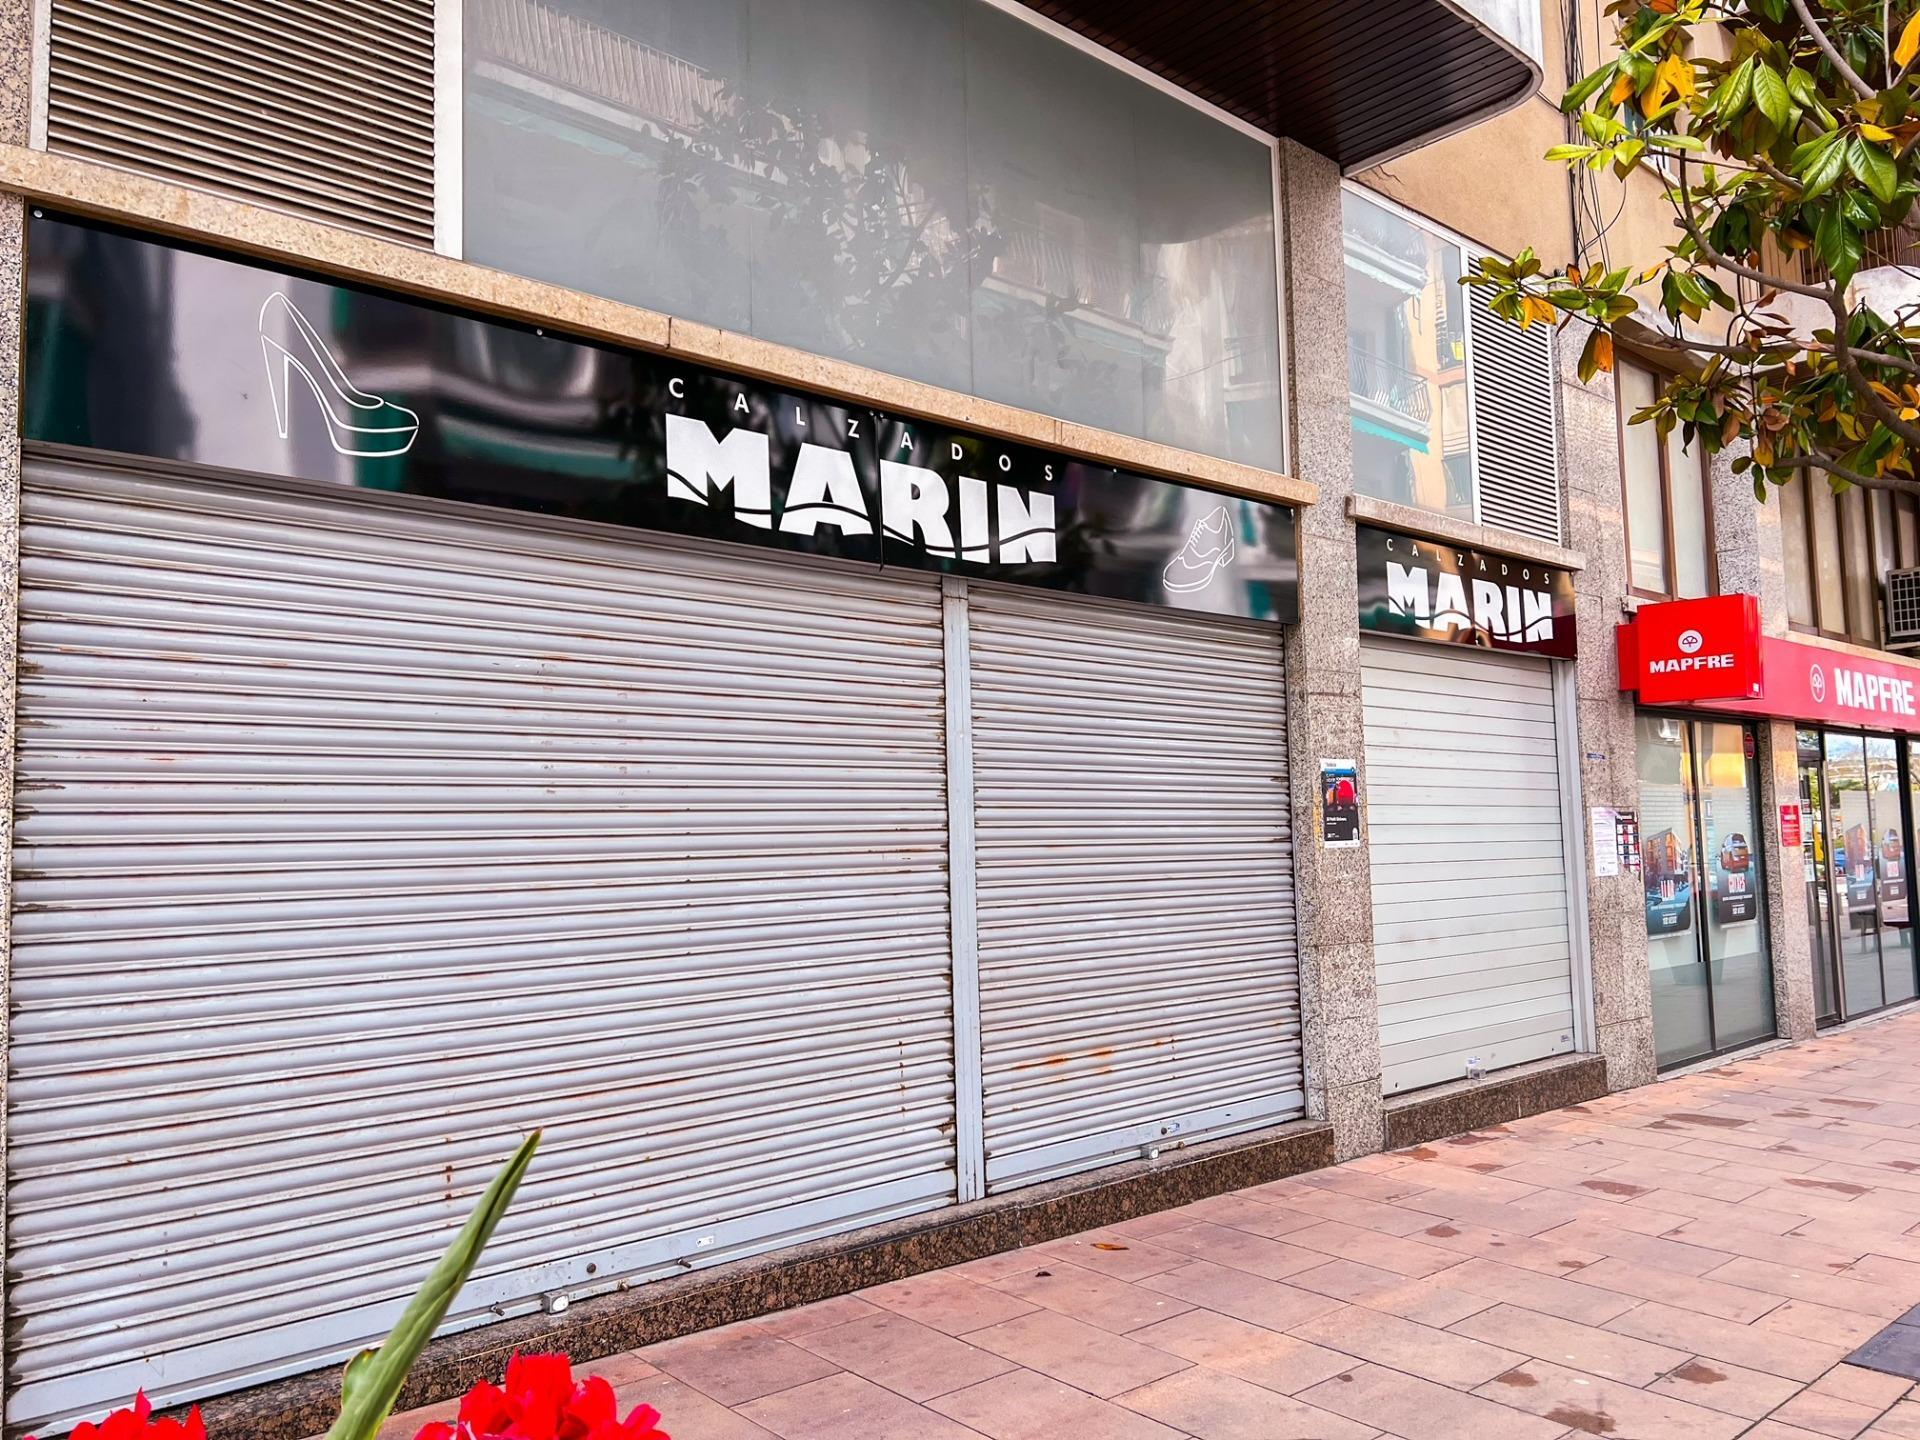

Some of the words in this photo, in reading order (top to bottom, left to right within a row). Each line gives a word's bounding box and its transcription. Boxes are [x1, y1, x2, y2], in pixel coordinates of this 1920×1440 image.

[668, 377, 1054, 482] CALZADOS
[665, 413, 1057, 564] MARIN
[1386, 538, 1550, 585] CALZADOS
[1386, 561, 1553, 643] MARIN
[1650, 654, 1734, 673] MAPFRE
[1834, 667, 1916, 715] MAPFRE
